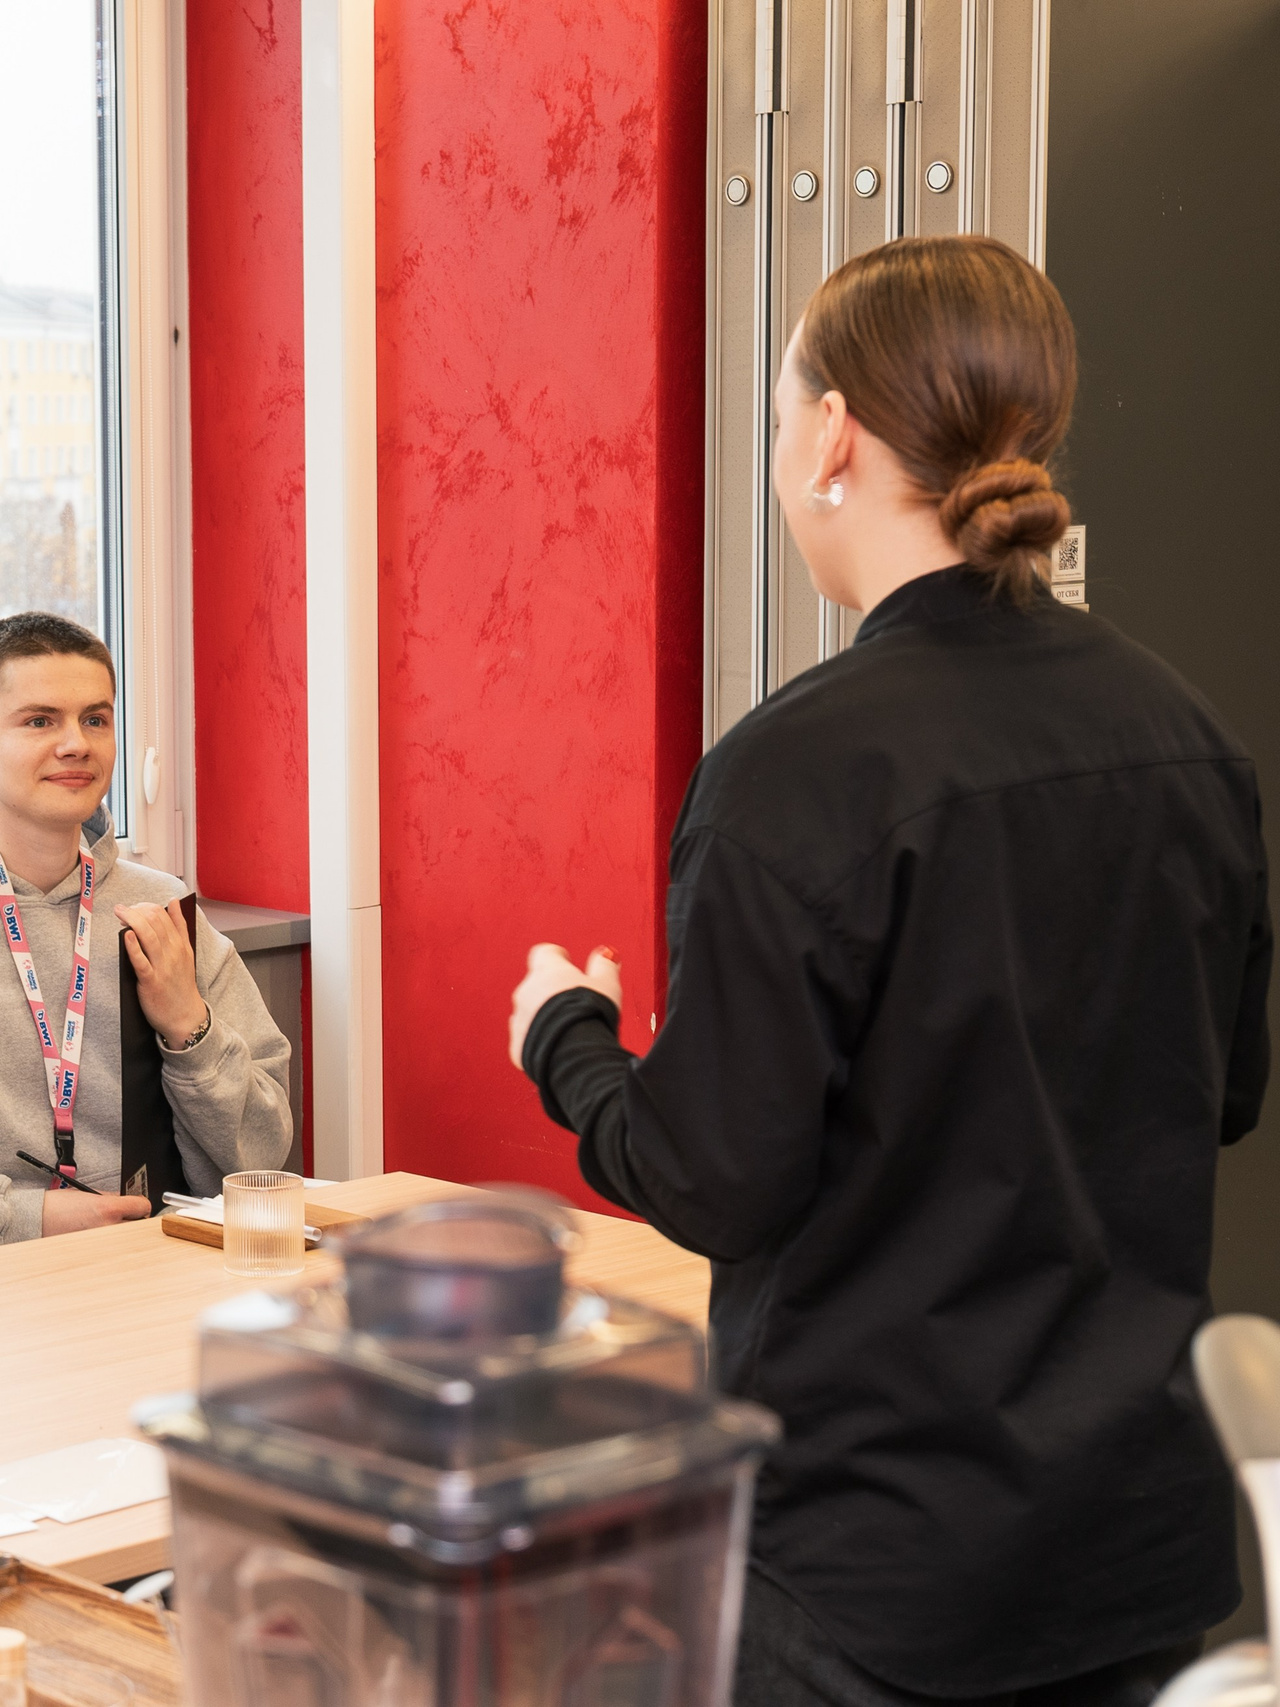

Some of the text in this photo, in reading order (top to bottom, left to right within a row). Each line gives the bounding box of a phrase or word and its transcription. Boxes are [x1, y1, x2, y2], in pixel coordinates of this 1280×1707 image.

[85, 864, 93, 887] BWT
[6, 915, 22, 941] BWT
[75, 965, 85, 991] BWT
[39, 1021, 52, 1047] BWT
[63, 1070, 74, 1097] BWT
